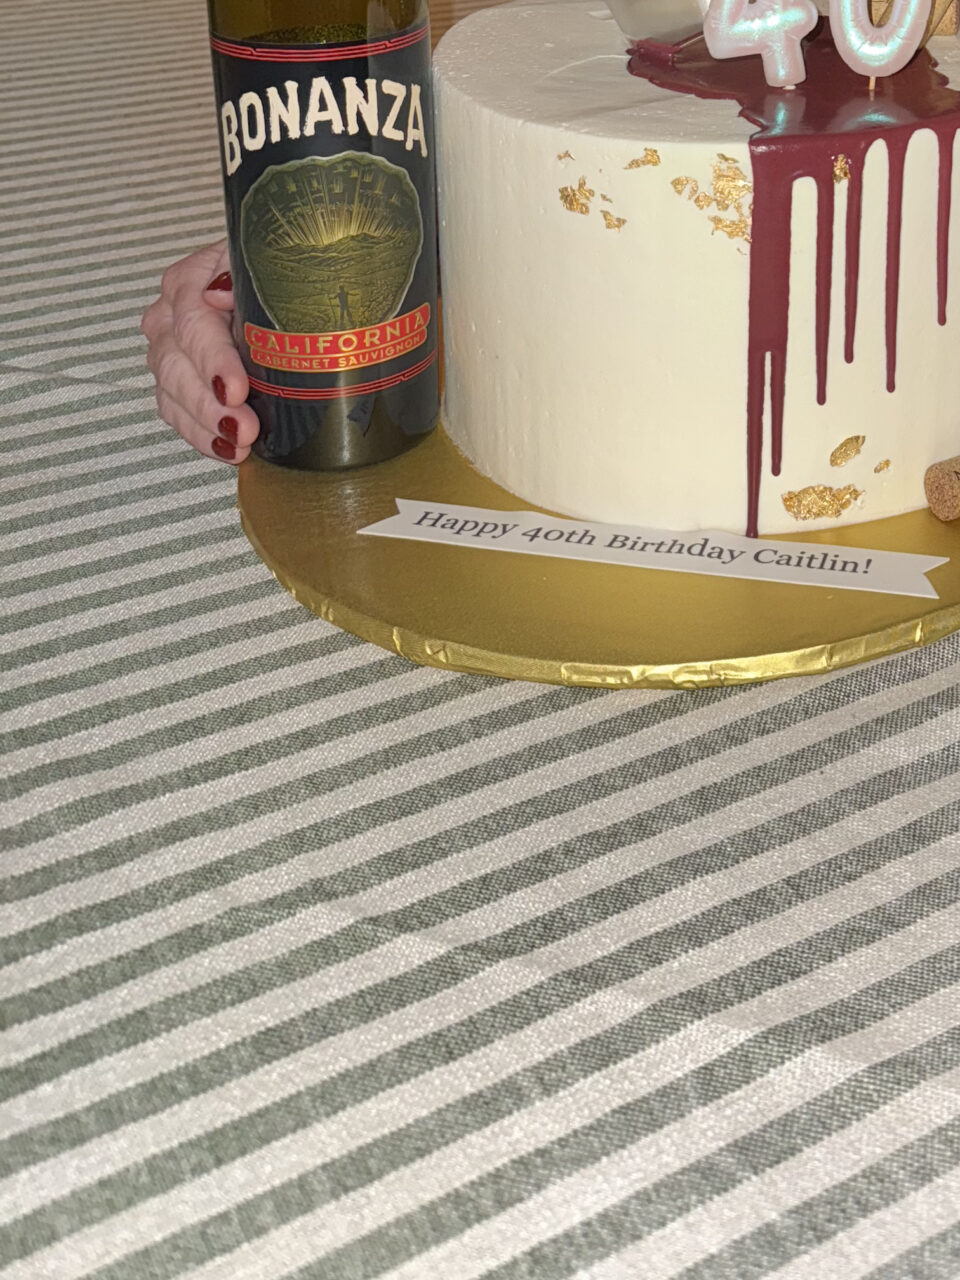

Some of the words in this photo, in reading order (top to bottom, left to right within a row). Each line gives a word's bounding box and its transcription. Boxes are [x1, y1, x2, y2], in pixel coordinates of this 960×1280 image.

[221, 76, 429, 177] BONANZA
[251, 311, 424, 354] CALIFORNIA
[257, 351, 330, 369] CABERNET
[338, 334, 420, 368] SAUVIGNON
[412, 510, 519, 539] Happy
[521, 526, 596, 546] 40th
[603, 534, 746, 565] Birthday
[753, 548, 873, 574] Caitlin!
